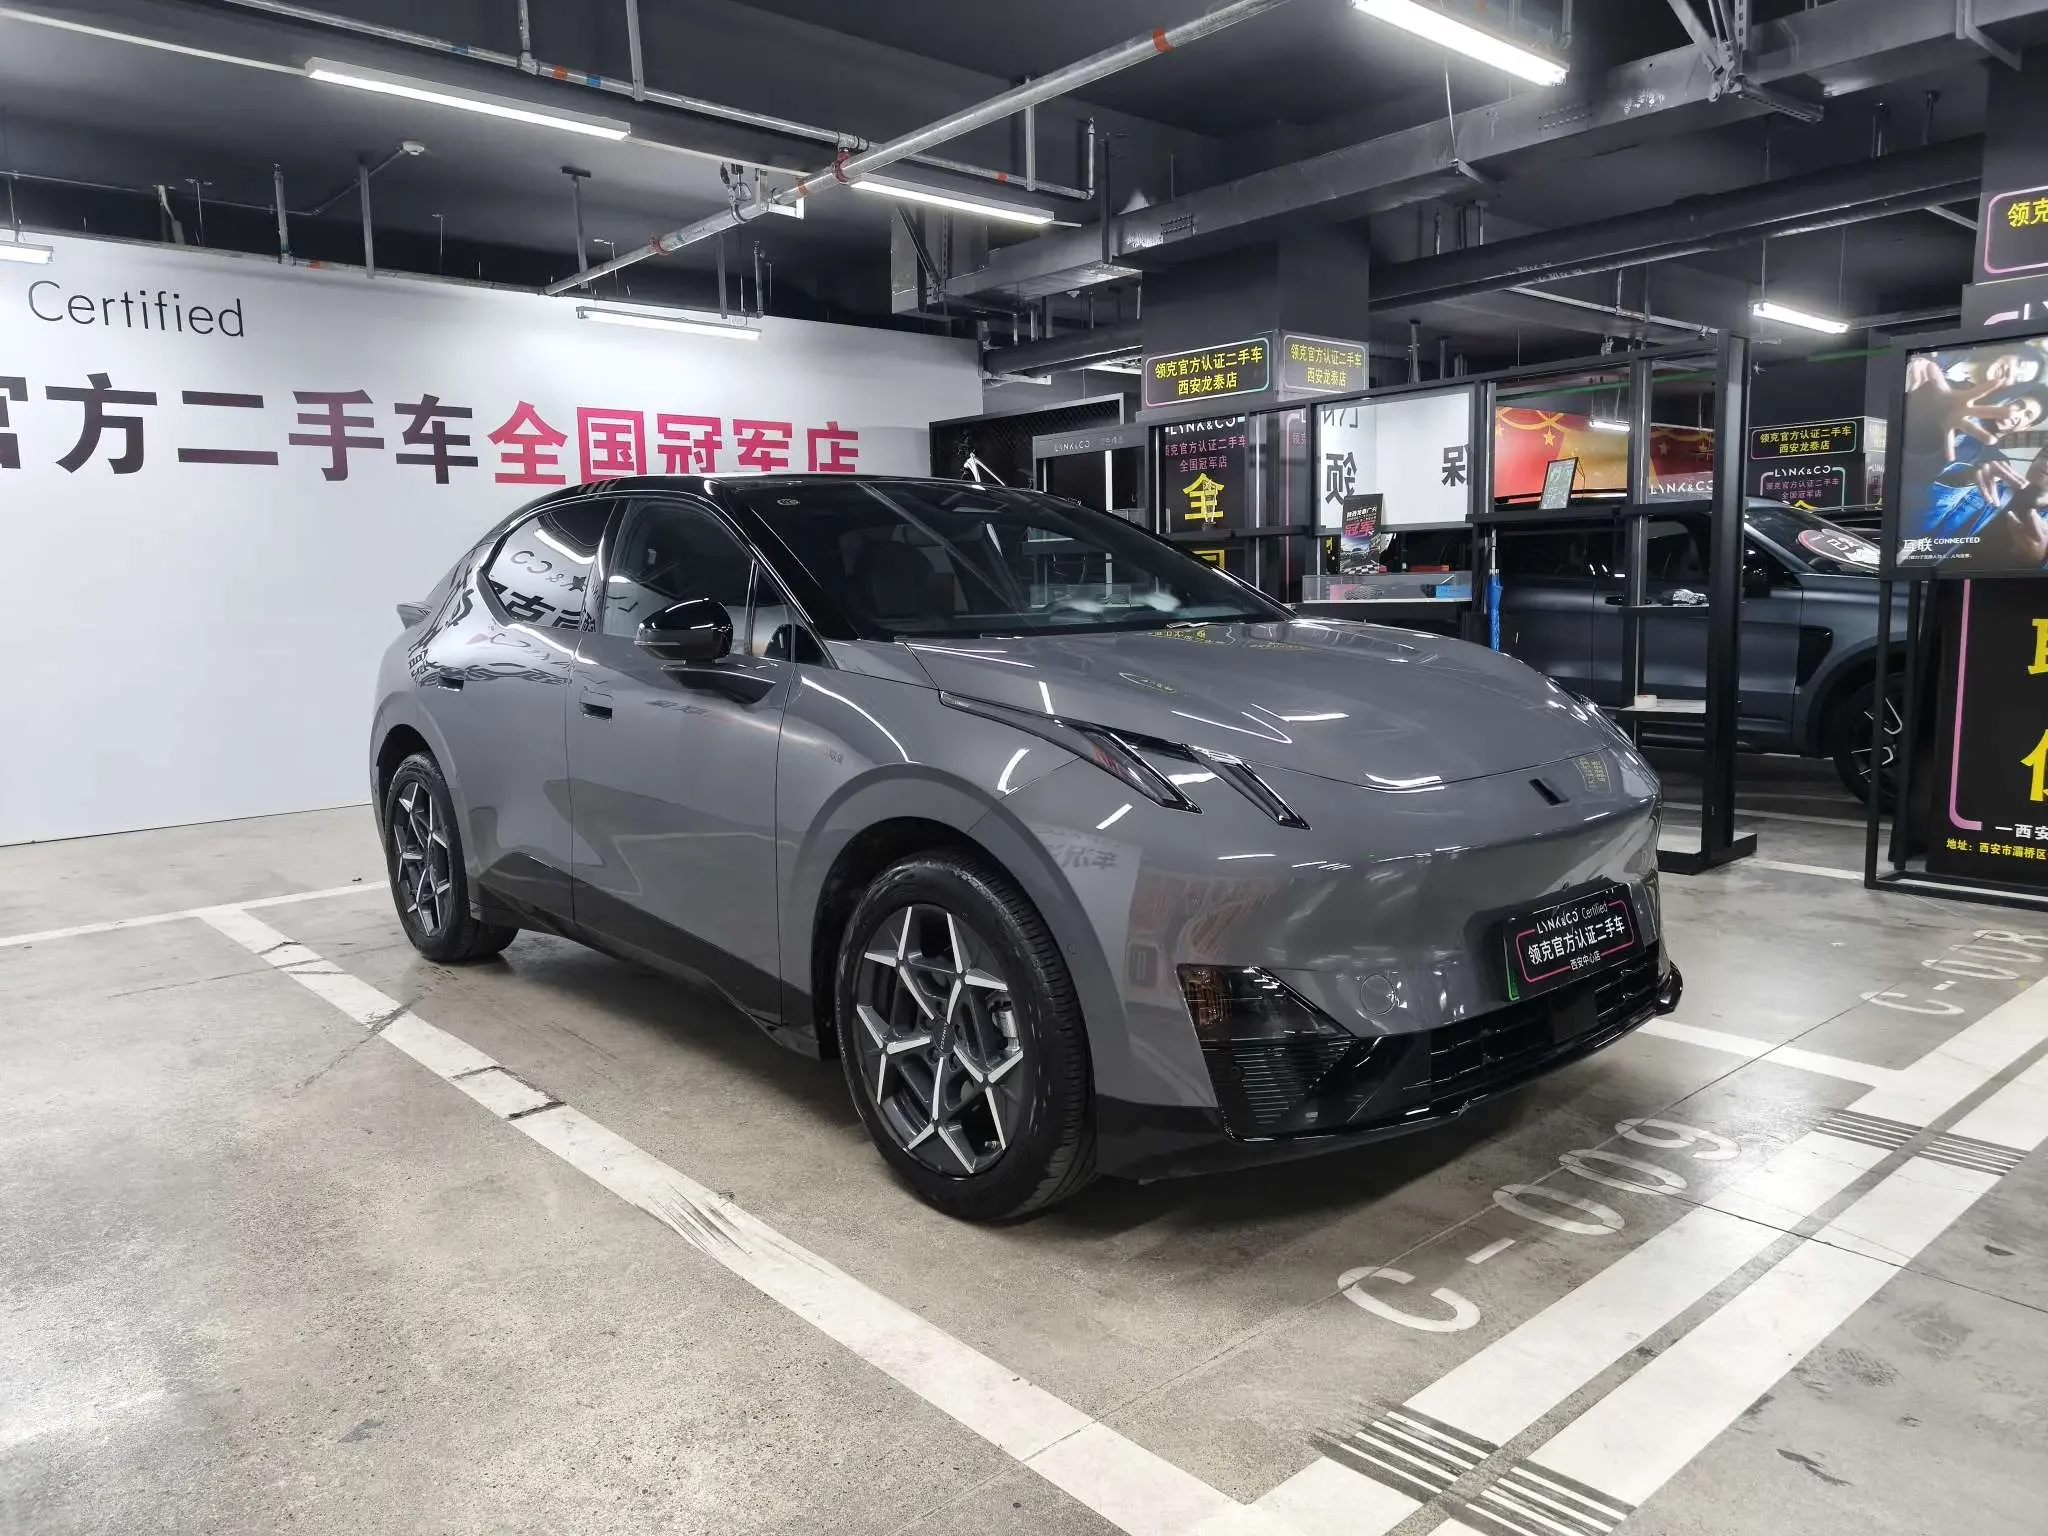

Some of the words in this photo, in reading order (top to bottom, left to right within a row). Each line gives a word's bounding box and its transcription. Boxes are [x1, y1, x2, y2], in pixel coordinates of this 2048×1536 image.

[28, 279, 245, 338] Certified
[1154, 346, 1264, 380] 领克官方认证二手车
[1289, 343, 1363, 368] 领克官方认证二手车
[1177, 371, 1238, 396] 西安龙泰店
[1306, 366, 1347, 389] 西安龙泰店
[0, 372, 860, 486] 方二手车全国冠军店
[1170, 416, 1236, 435] LYNK&CO
[1760, 425, 1852, 444] 领克官方认证二手车
[1779, 440, 1832, 454] 西安龙泰店
[1179, 455, 1228, 473] 全国冠军店
[1774, 465, 1832, 477] LYNK&CO
[1933, 536, 1981, 545] CONNECTED
[1536, 907, 1579, 935] LYNK&CO
[1581, 900, 1608, 920] Certified
[1528, 915, 1625, 965] 领克官方认证二手车
[1569, 950, 1601, 971] 西安中心店
[1336, 1117, 1742, 1333] C-009
